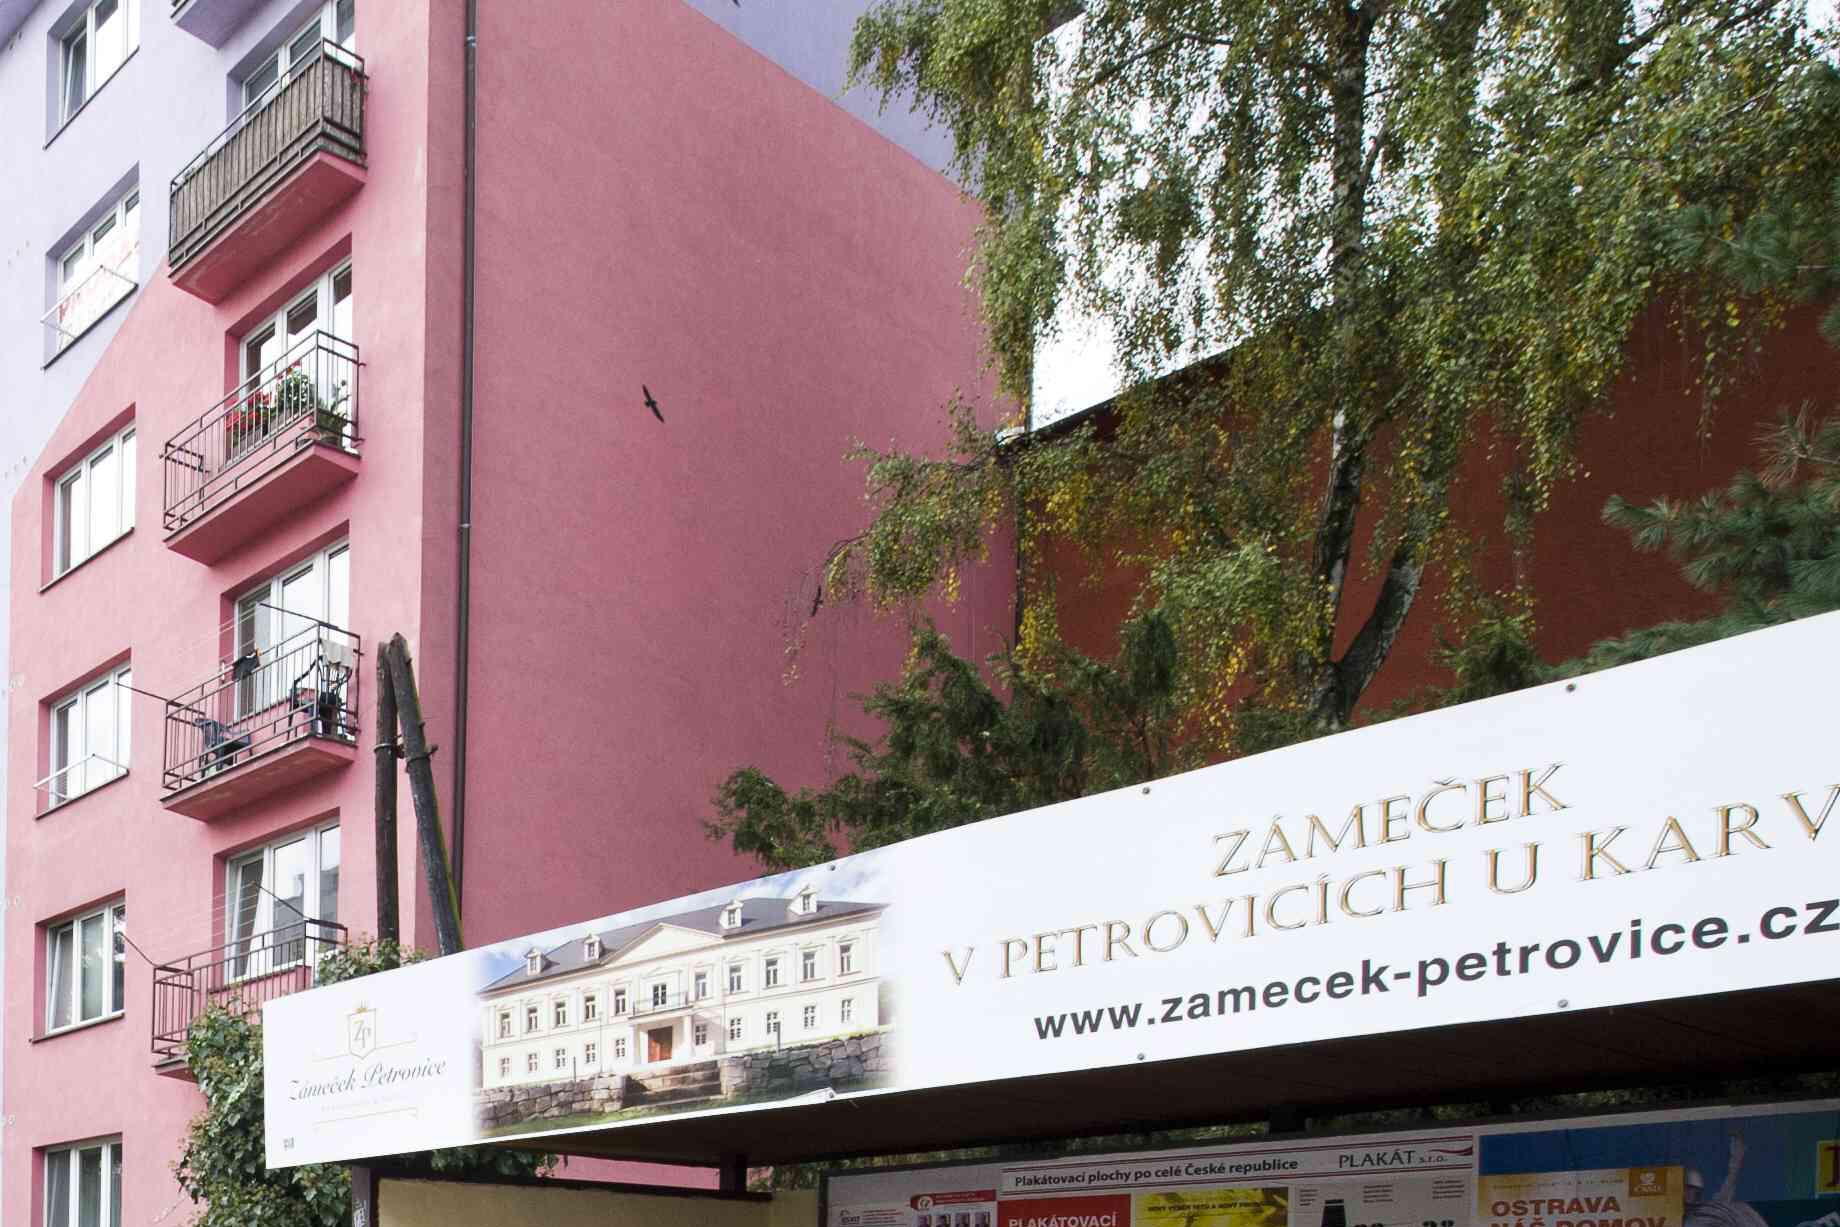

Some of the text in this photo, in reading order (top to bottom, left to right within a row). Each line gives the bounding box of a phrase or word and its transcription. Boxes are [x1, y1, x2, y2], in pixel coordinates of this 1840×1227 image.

[1212, 760, 1574, 879] ZÁMEČEK
[941, 945, 976, 987] V
[998, 855, 1455, 980] PETROVICÍCH
[1483, 838, 1544, 895] U
[1034, 898, 1840, 1040] www.zamecek-petrovice.cz
[1015, 1158, 1298, 1187] Plakátovací plochy po celé České republice
[1339, 1149, 1416, 1168] PLAKÁT
[1491, 1197, 1621, 1217] OSTRAVA
